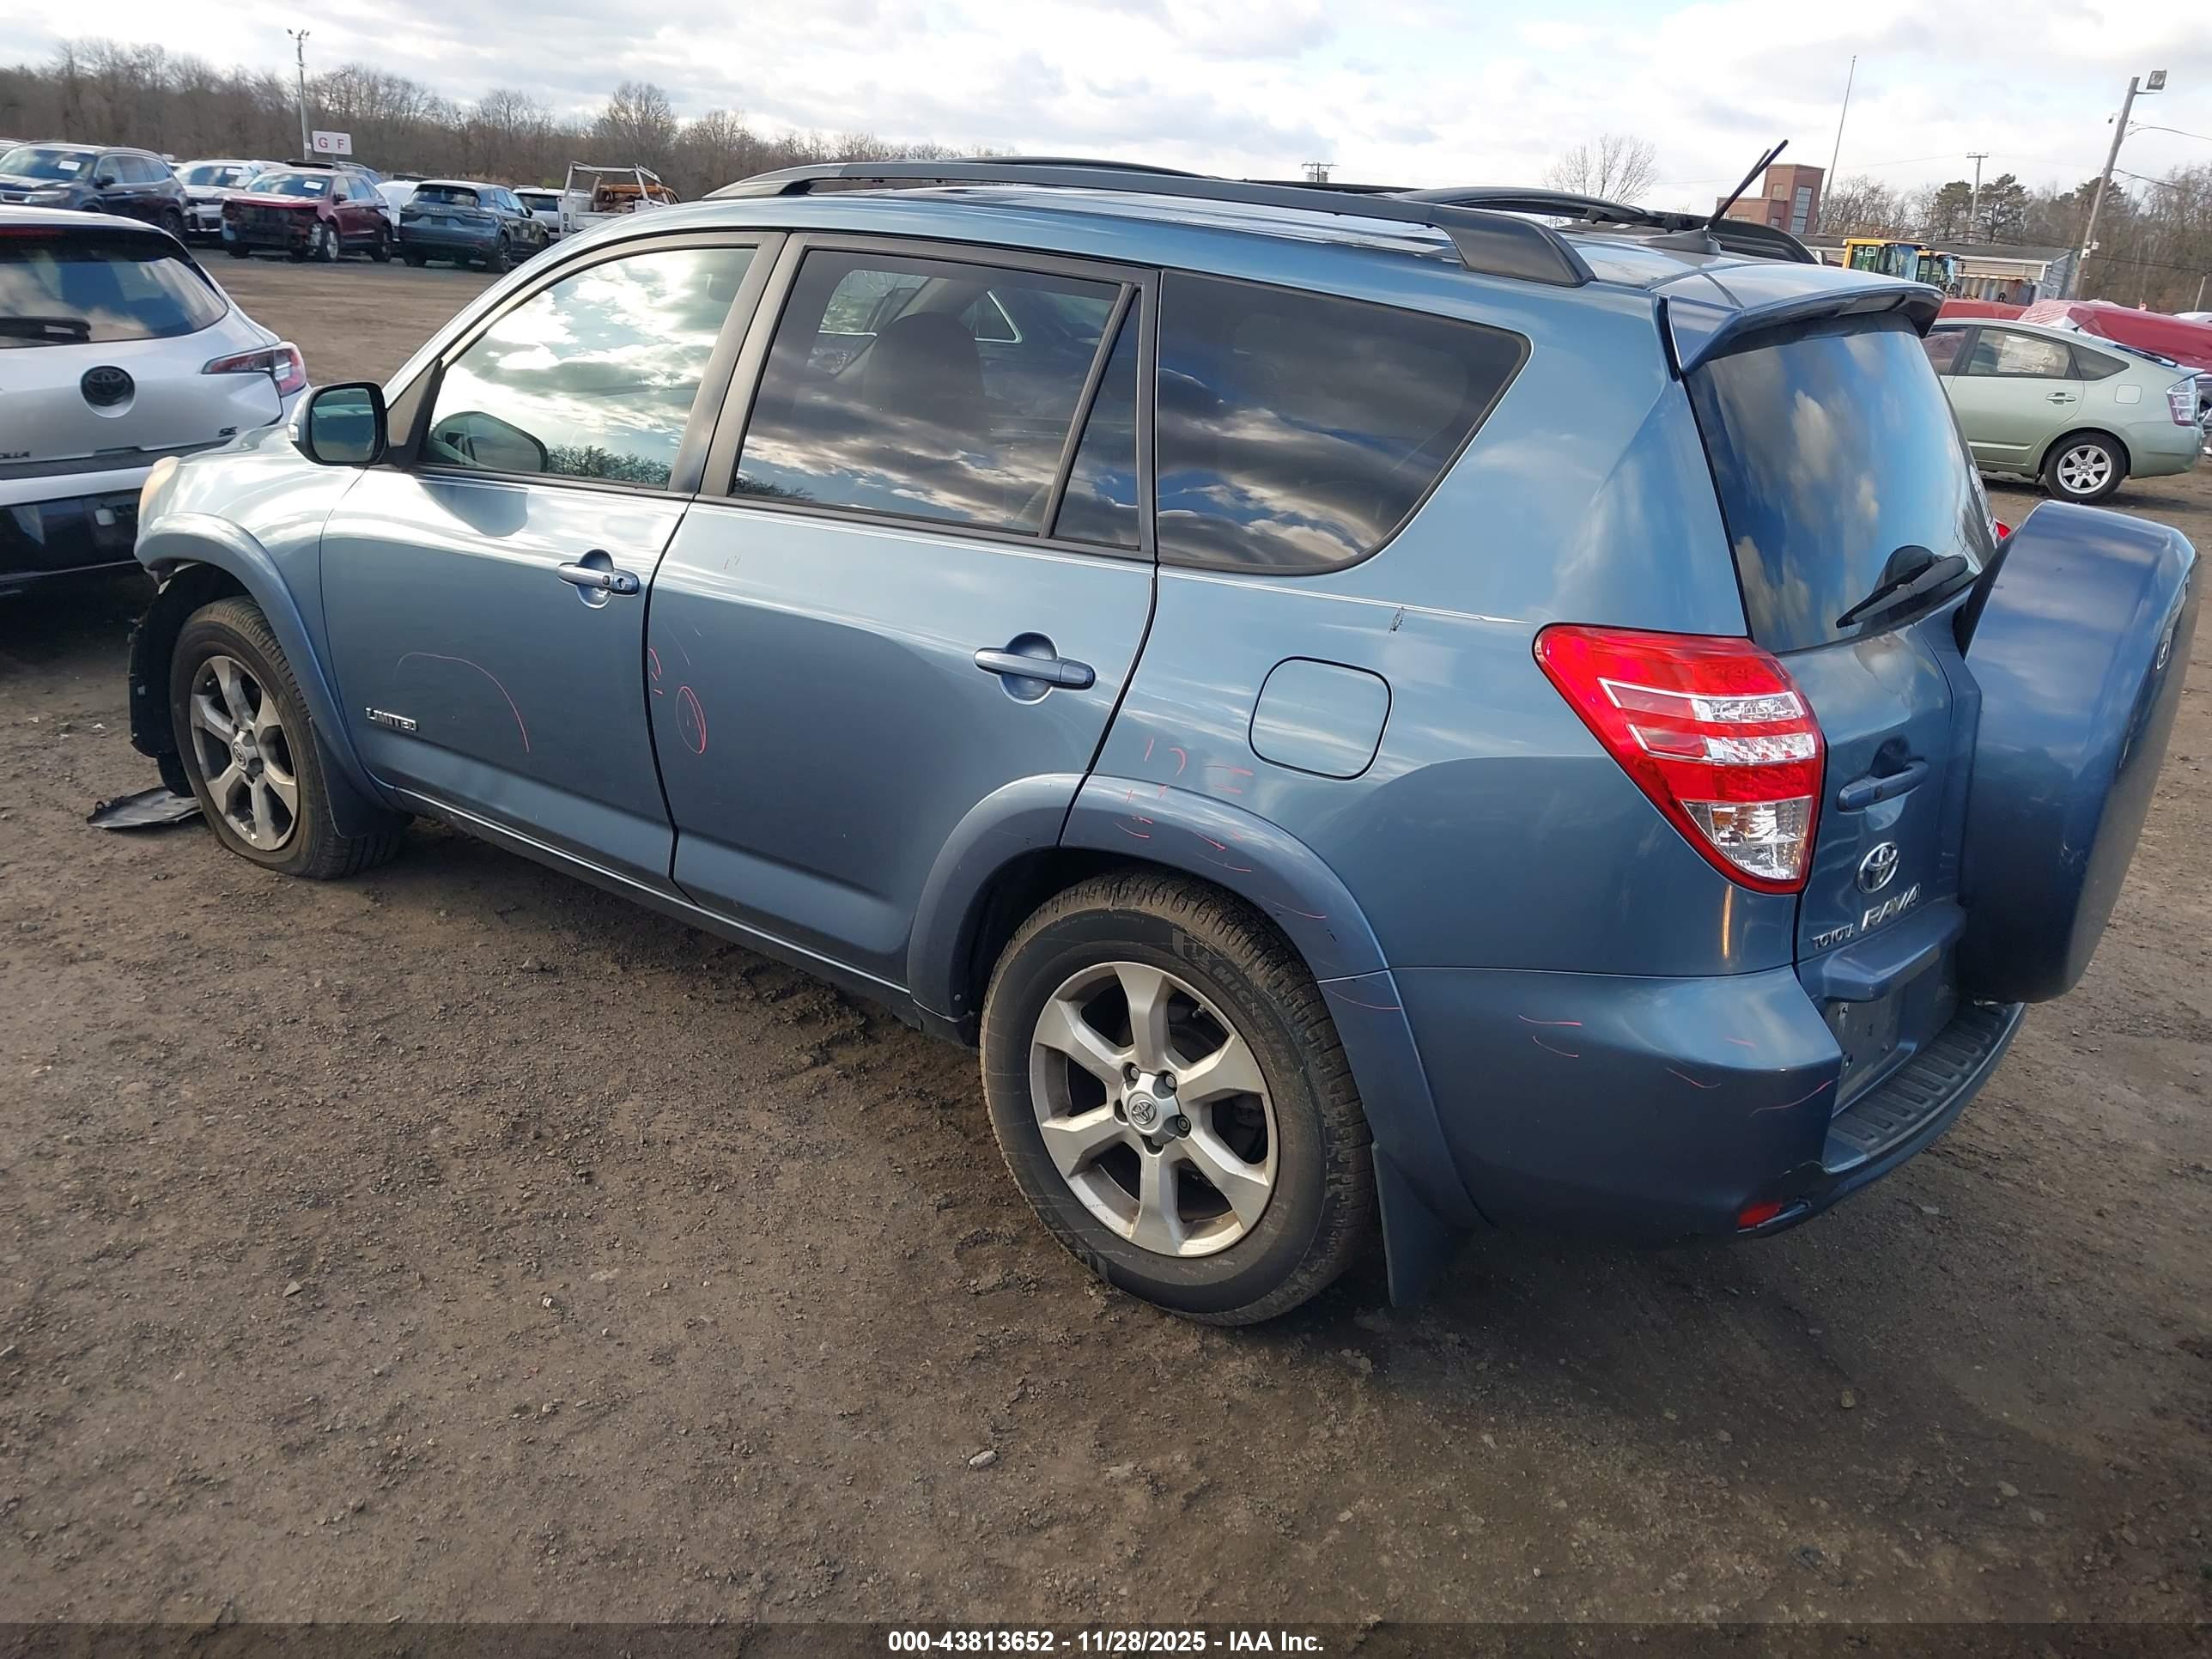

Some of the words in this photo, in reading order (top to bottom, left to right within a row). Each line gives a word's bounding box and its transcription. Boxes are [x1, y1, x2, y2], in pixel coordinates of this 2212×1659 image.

[318, 137, 328, 149] G
[337, 138, 344, 149] F
[365, 707, 418, 732] LIMITED
[1811, 923, 1855, 950] TOYOTA
[1861, 882, 1922, 933] RAV4
